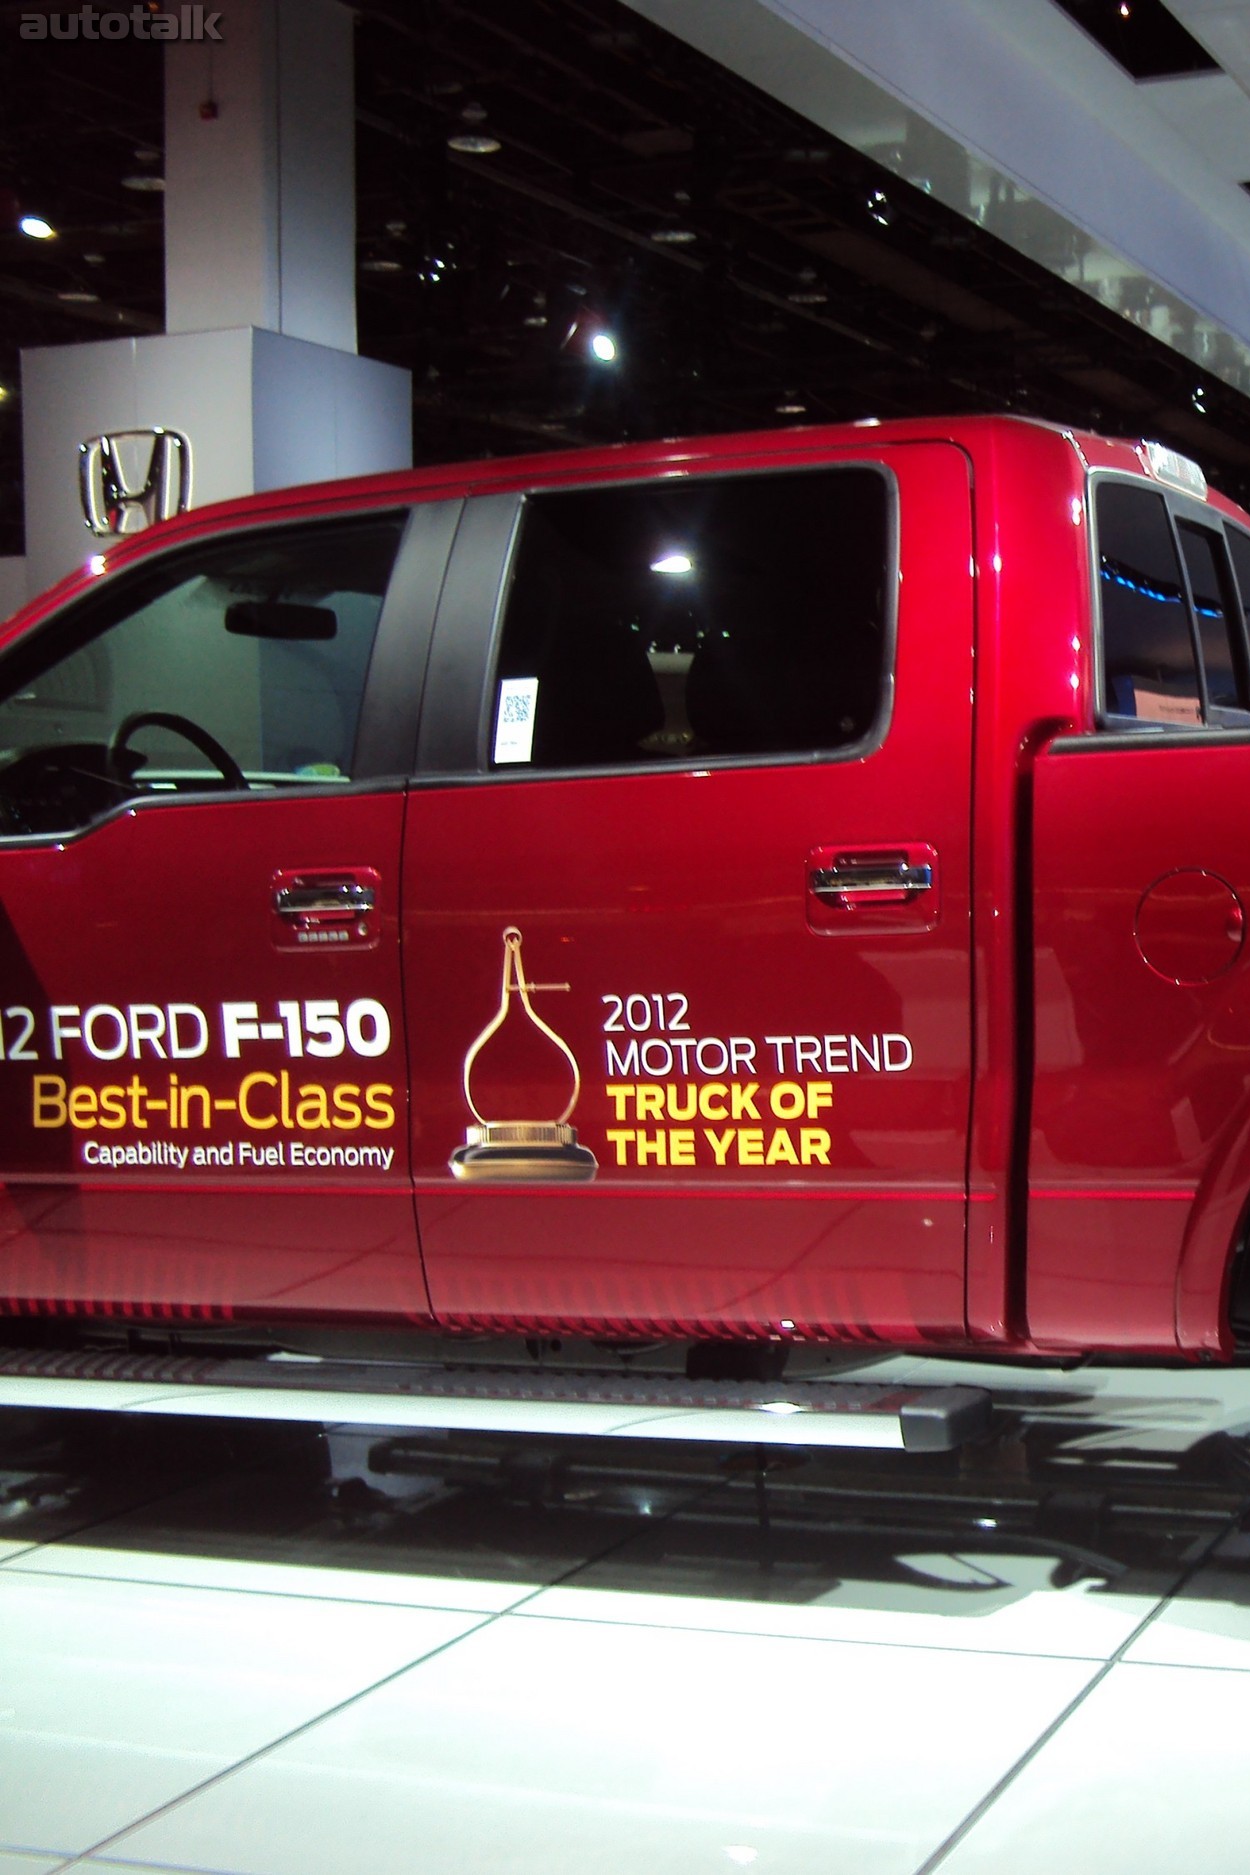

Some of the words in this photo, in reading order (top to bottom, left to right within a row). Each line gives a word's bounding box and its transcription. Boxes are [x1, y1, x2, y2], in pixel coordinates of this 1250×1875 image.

[50, 1003, 209, 1061] FORD
[222, 999, 391, 1059] F-150
[602, 993, 691, 1032] 2012
[606, 1036, 757, 1076] MOTOR
[765, 1033, 913, 1074] TREND
[33, 1070, 395, 1129] Best-in-Class
[605, 1082, 762, 1121] TRUCK
[769, 1081, 833, 1120] OF
[84, 1141, 188, 1169] Capability
[192, 1141, 233, 1166] and
[238, 1142, 285, 1166] Fuel
[290, 1142, 395, 1170] Economy
[606, 1128, 696, 1166] THE
[703, 1127, 832, 1166] YEAR
